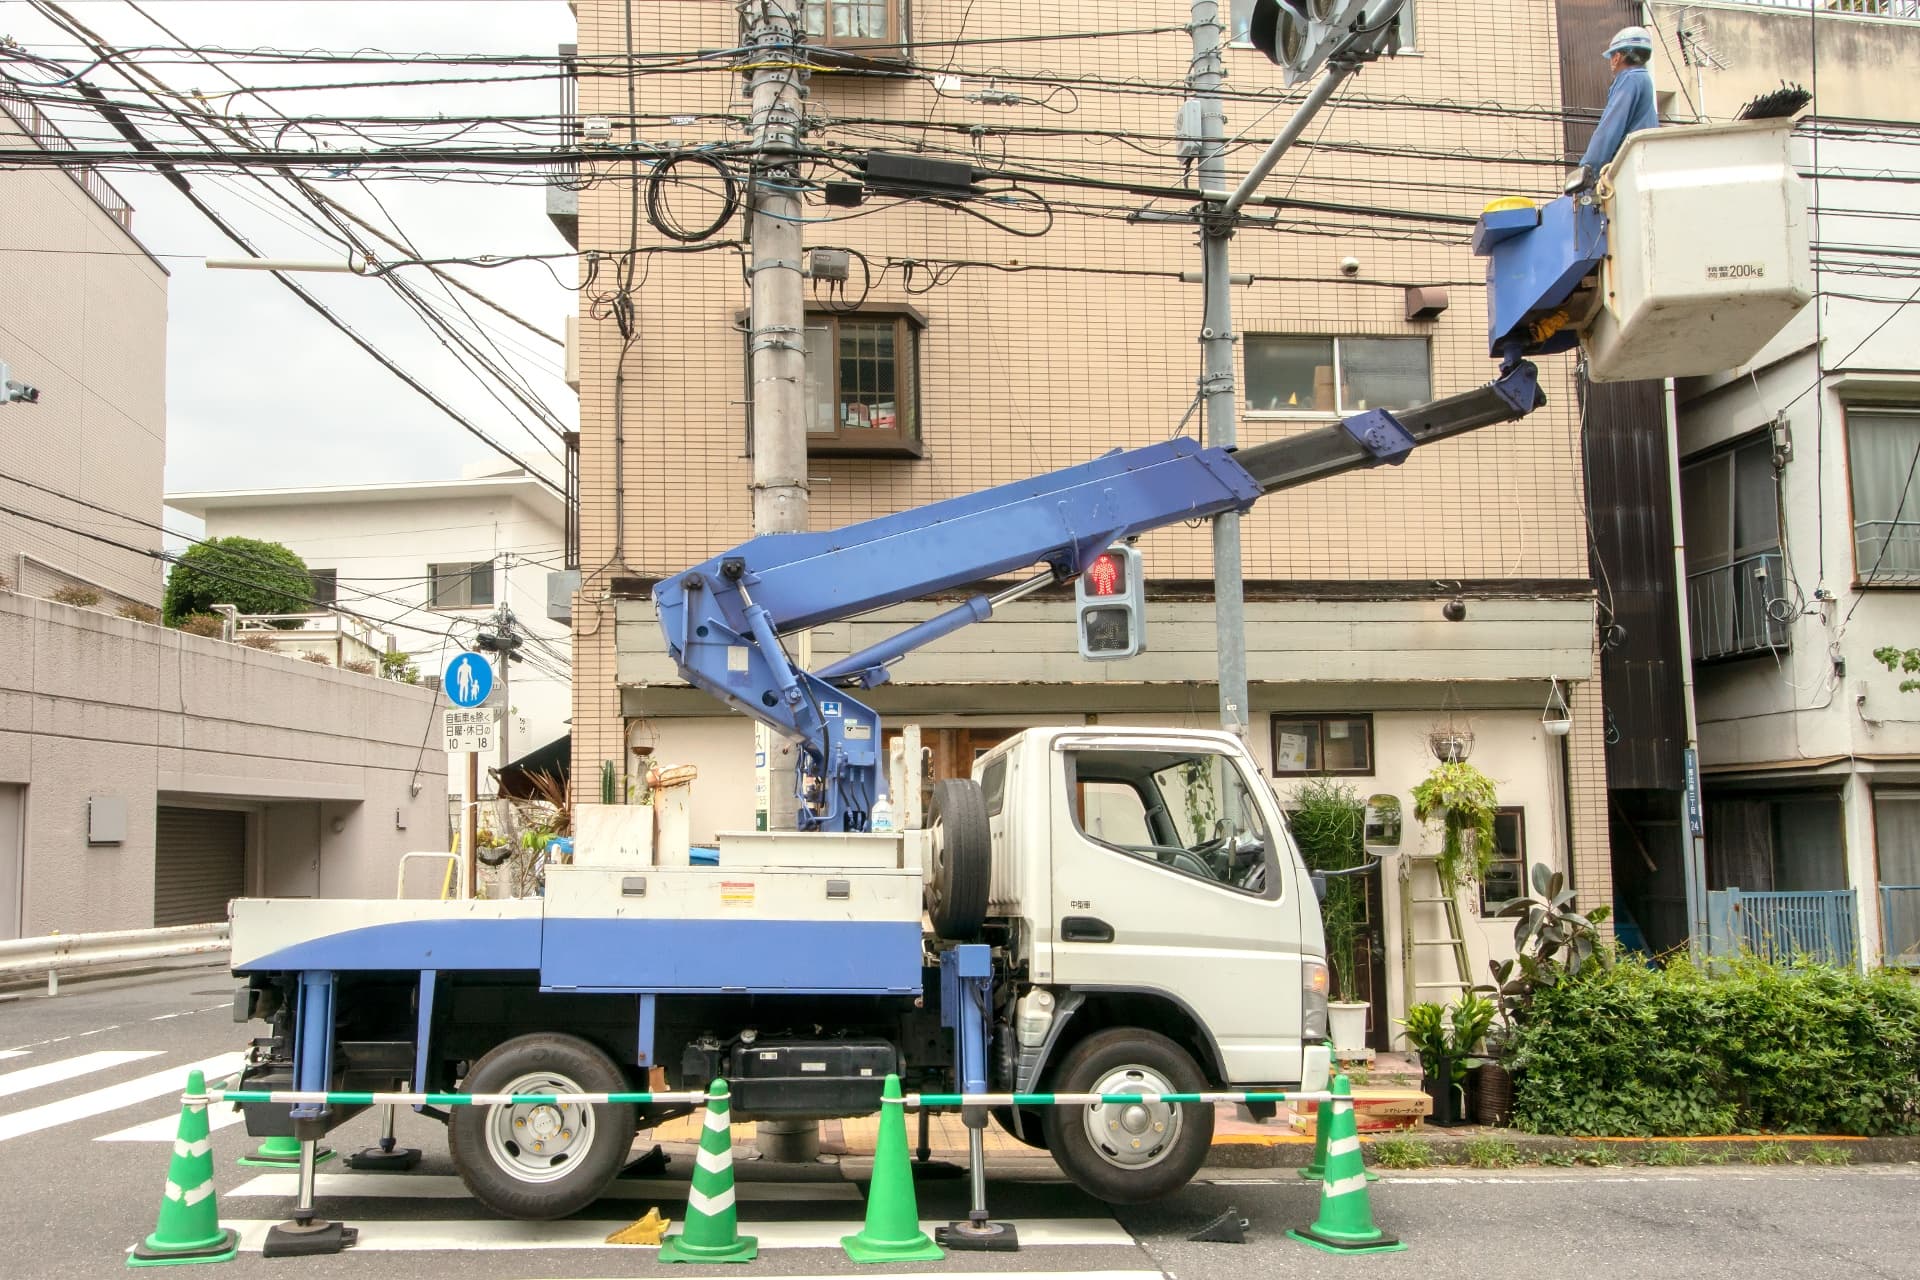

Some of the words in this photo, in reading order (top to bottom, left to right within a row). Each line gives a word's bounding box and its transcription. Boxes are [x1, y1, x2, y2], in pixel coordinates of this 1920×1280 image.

[1729, 265, 1764, 277] 200kg
[446, 711, 491, 723] 自転車を除く
[449, 738, 459, 750] 10
[478, 737, 488, 749] 18
[1690, 820, 1699, 831] 24
